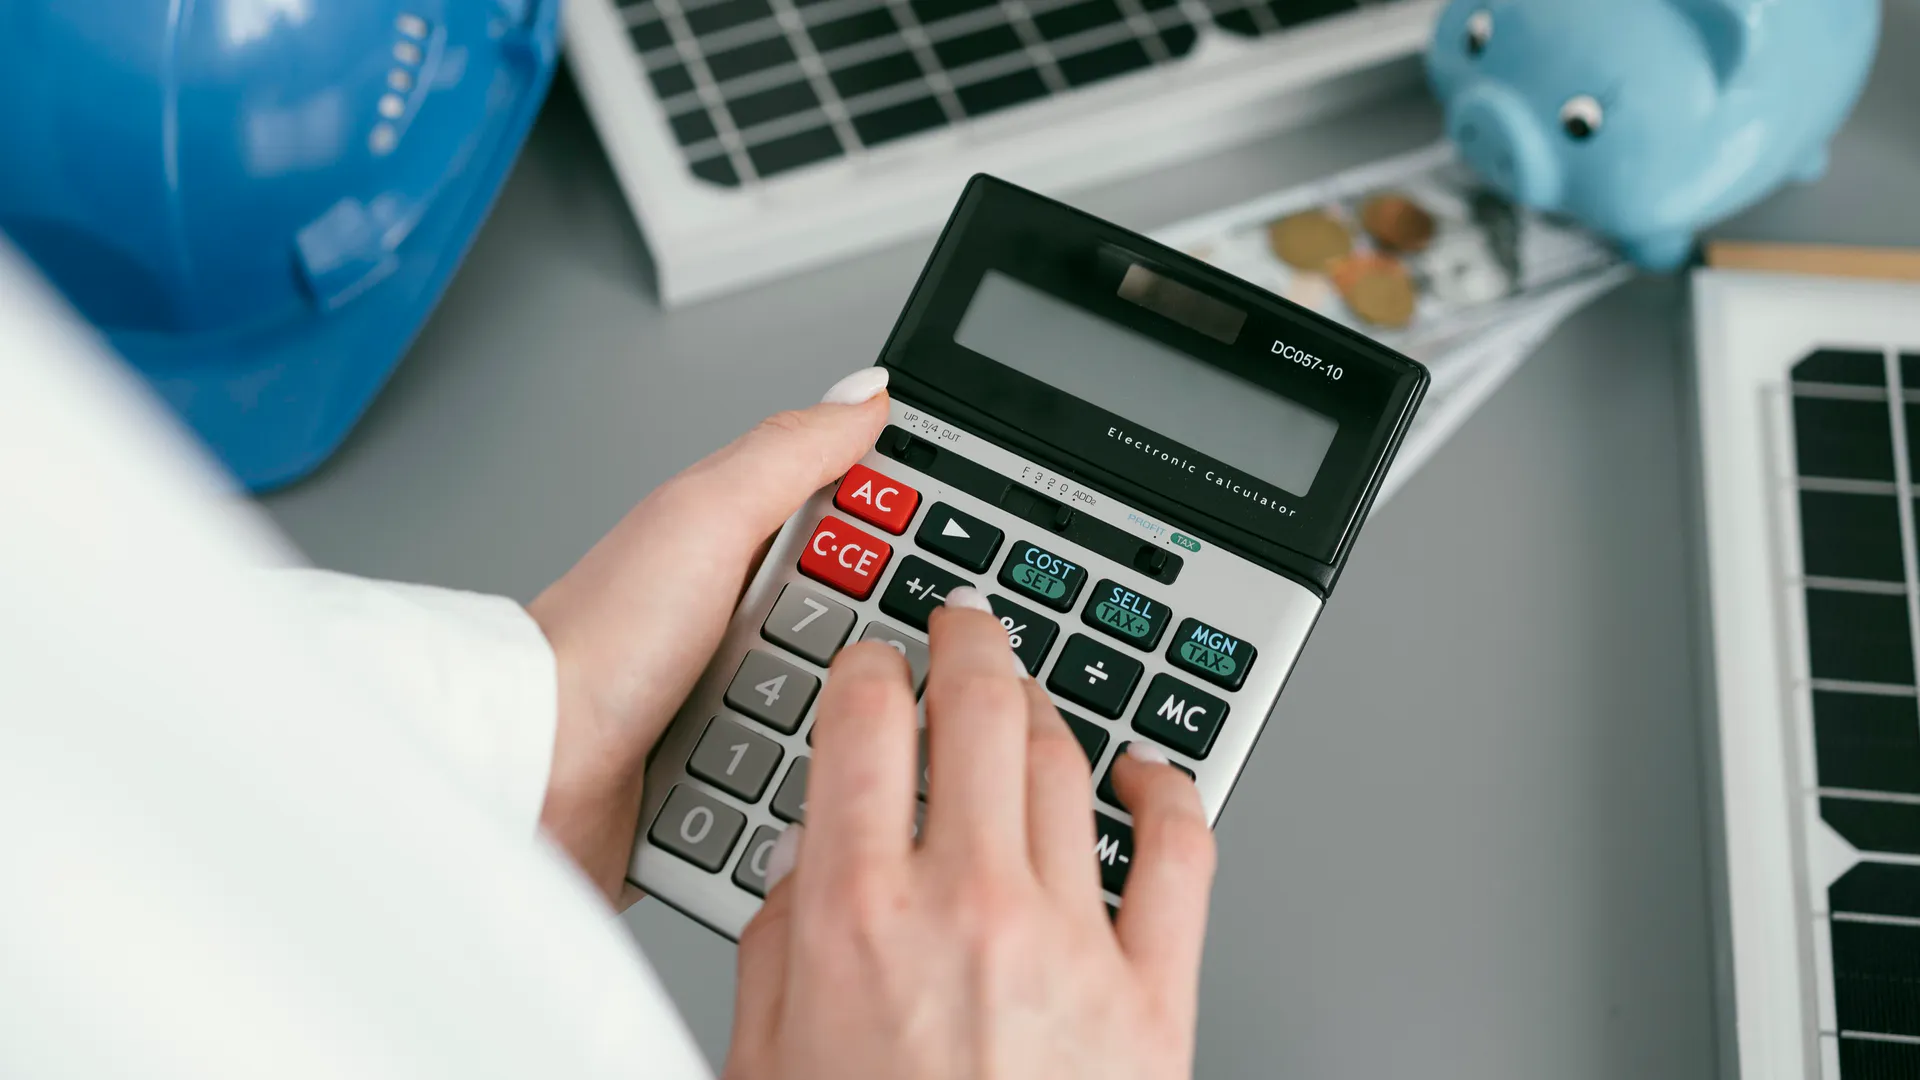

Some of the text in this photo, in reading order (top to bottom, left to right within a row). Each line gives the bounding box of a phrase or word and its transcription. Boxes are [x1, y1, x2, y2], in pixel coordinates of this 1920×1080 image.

[1271, 340, 1343, 381] DC057-10
[904, 412, 962, 443] UP 5/4 CUT
[1022, 466, 1031, 476] F
[1035, 472, 1043, 482] 3
[1048, 478, 1056, 488] 2
[1107, 427, 1297, 518] Electronic Calculator
[851, 480, 899, 512] AC
[1127, 513, 1195, 550] PROFIT TAX
[1024, 548, 1076, 580] COST
[1021, 569, 1058, 595] SET
[791, 597, 829, 632] 7
[1101, 603, 1145, 635] TAX+
[1110, 587, 1152, 620] SELL
[1191, 625, 1238, 656] MGN
[755, 674, 788, 707] 4
[1157, 694, 1207, 732] MC
[726, 742, 750, 776] 1
[680, 806, 714, 844] 0
